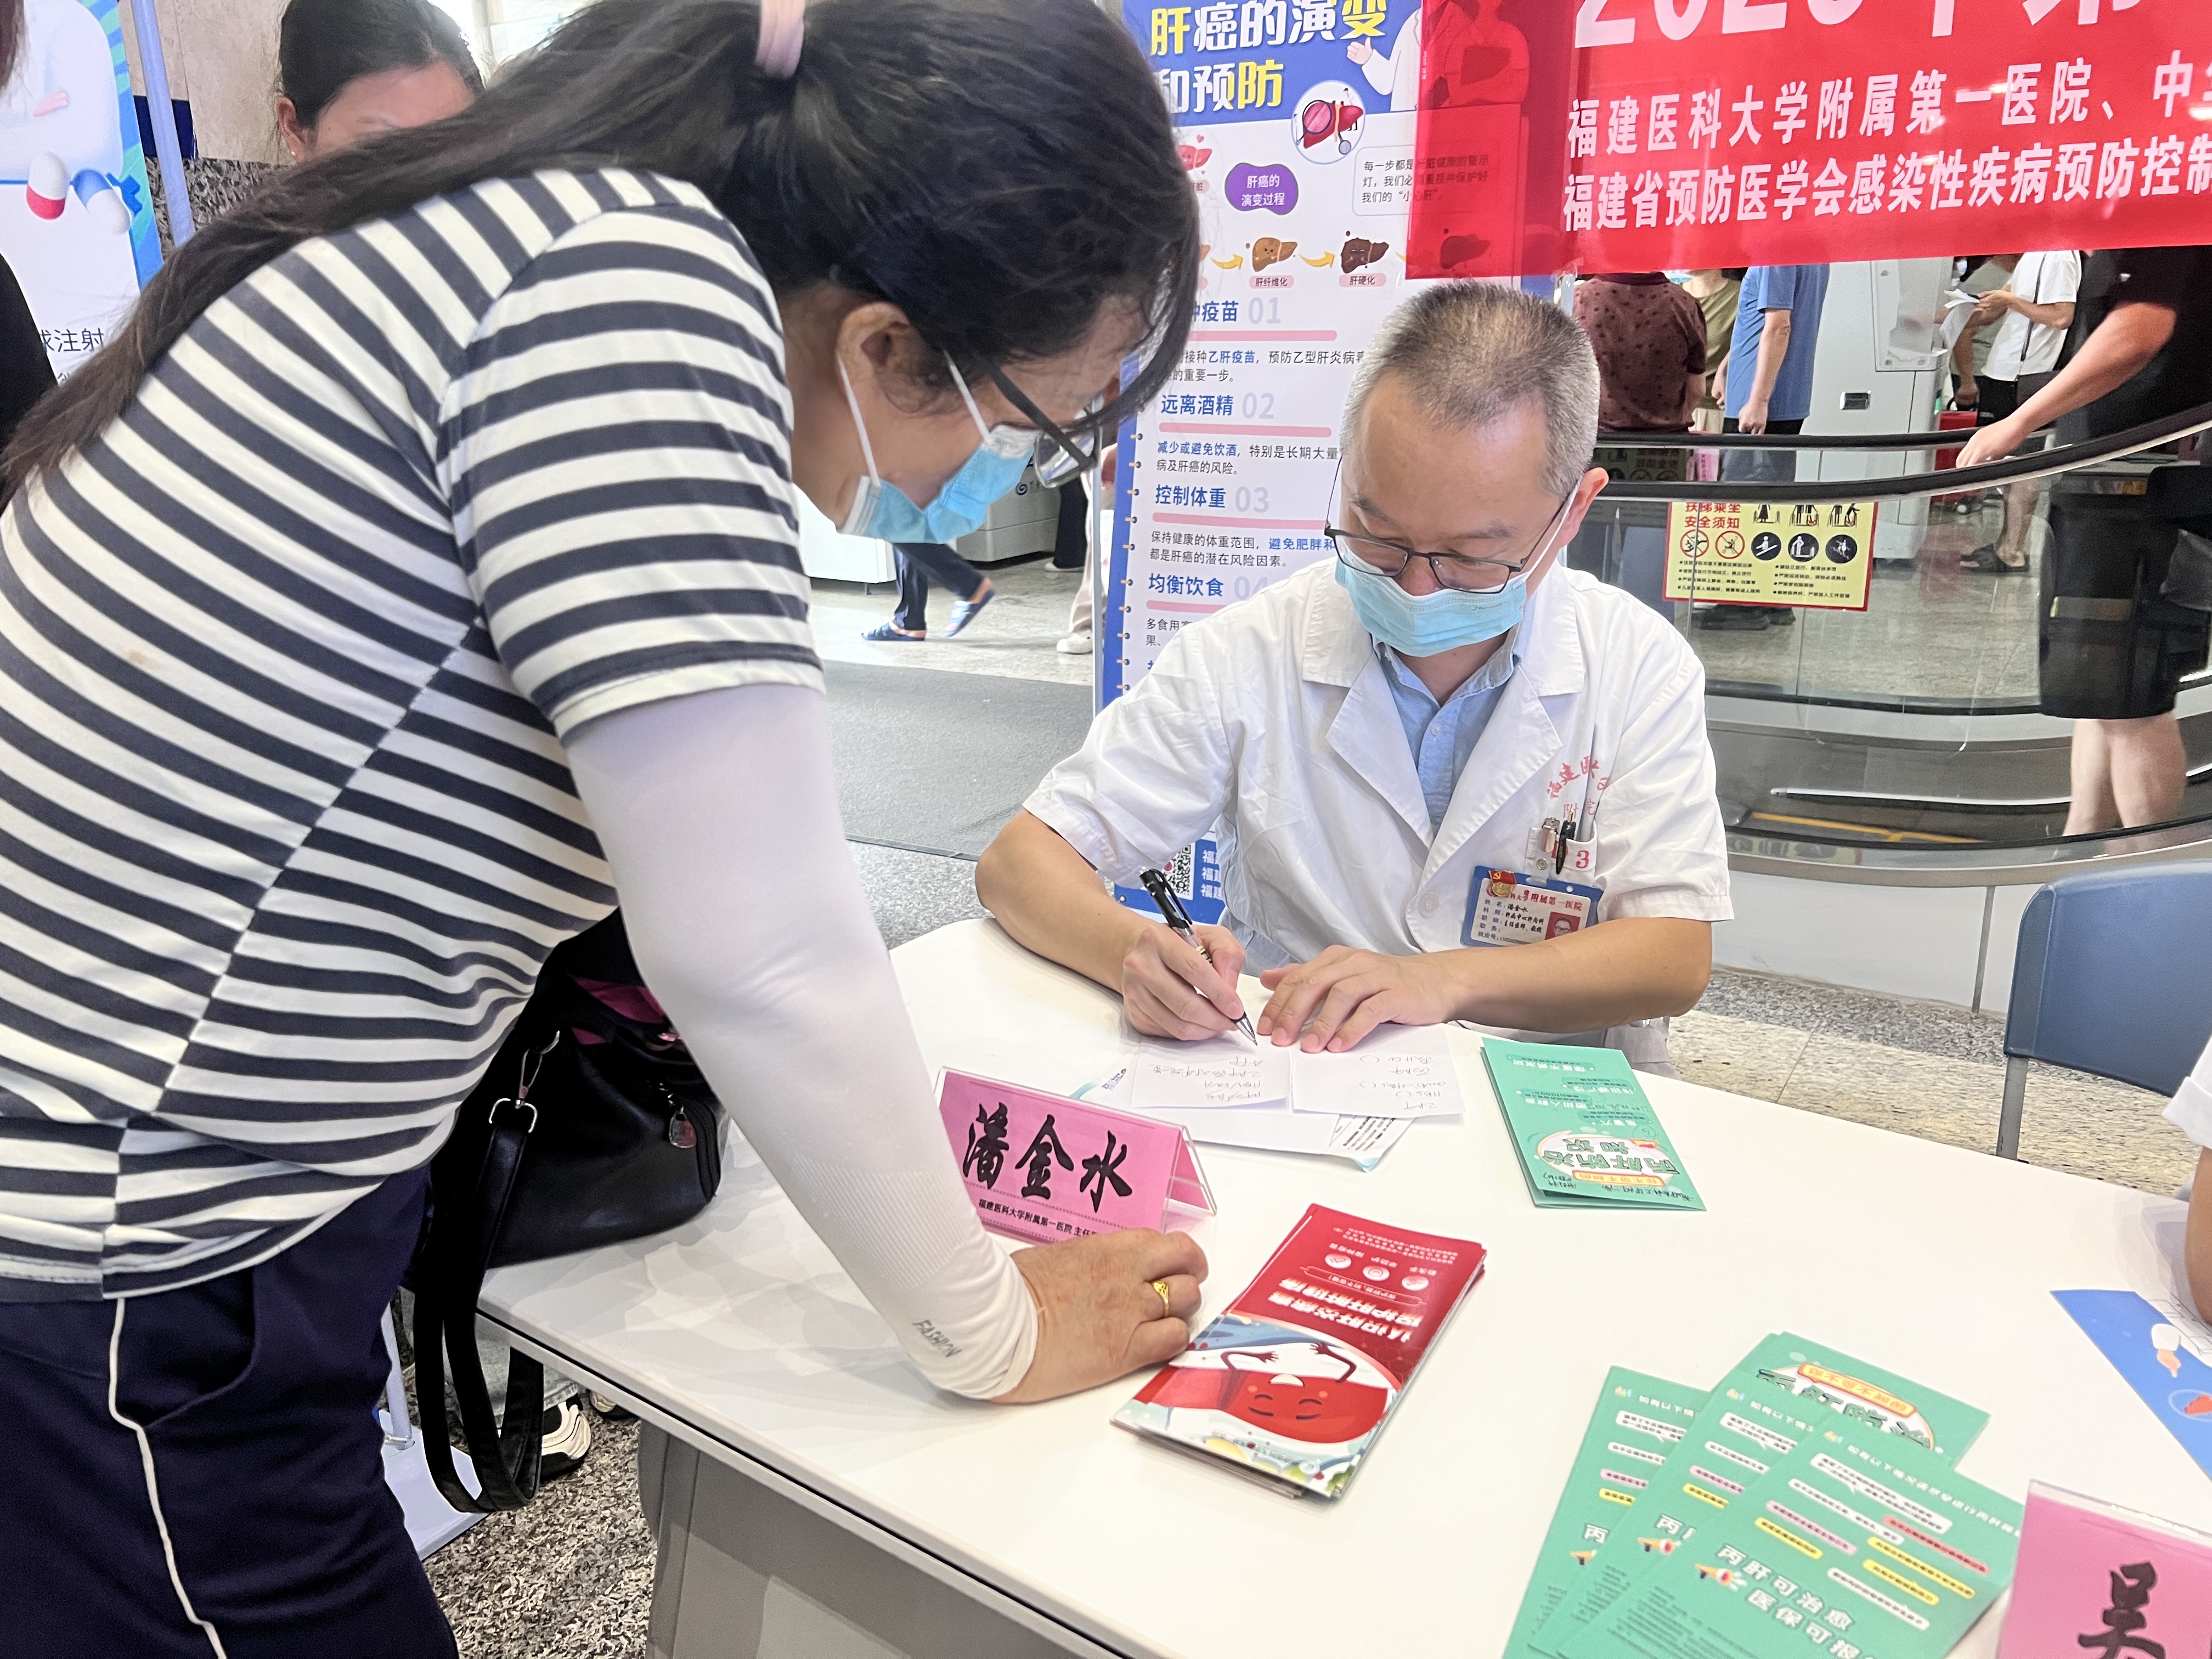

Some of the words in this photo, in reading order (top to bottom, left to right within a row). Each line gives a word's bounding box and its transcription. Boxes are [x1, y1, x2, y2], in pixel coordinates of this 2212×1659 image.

[1151, 0, 1387, 56] 肝癌的演变
[1153, 59, 1283, 114] 和预防
[1246, 174, 1280, 189] 肝癌的
[1242, 192, 1285, 207] 演变过程
[1255, 278, 1288, 287] 肝纤维化
[1349, 276, 1375, 285] 肝硬化
[1249, 297, 1281, 324] 01
[1160, 394, 1234, 416] 远离酒精
[1243, 392, 1274, 420] 02
[1155, 484, 1226, 509] 控制体重
[1235, 487, 1269, 514] 03
[1685, 516, 1740, 529] 安全须知
[1148, 573, 1224, 597] 均衡饮食
[962, 1101, 1133, 1213] 潘金水
[1562, 1139, 1629, 1155] 知识
[1542, 1150, 1680, 1175] 丙肝防治
[978, 1198, 1073, 1234] 福建医科大学附属第一医院
[1279, 1277, 1423, 1328] 保护肝脏健康
[1268, 1291, 1413, 1343] 认识肝炎病毒
[1639, 1395, 1701, 1419] 如有以下情
